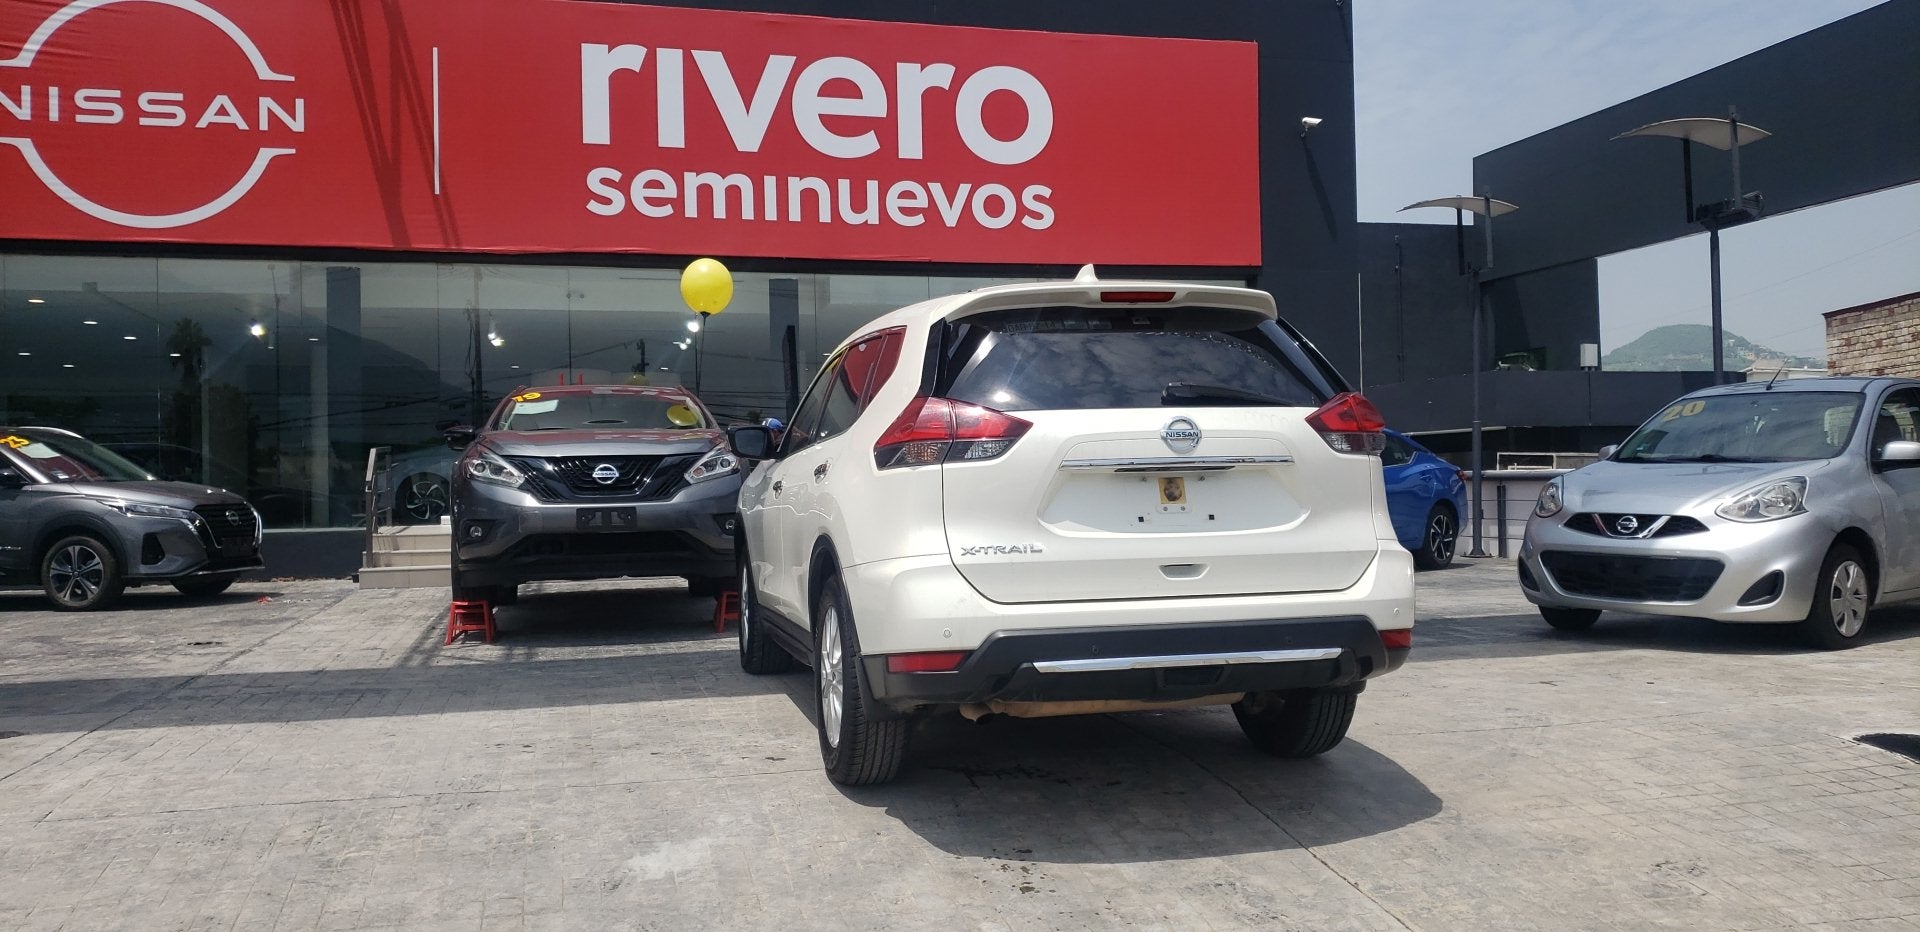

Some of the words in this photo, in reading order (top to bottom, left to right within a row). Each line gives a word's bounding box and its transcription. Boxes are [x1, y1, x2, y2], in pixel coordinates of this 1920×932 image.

[0, 84, 305, 133] NISSAN
[580, 42, 1054, 165] rivero
[585, 166, 1056, 231] seminuevos
[1662, 400, 1706, 422] 20
[960, 544, 1043, 556] X-TRAIL
